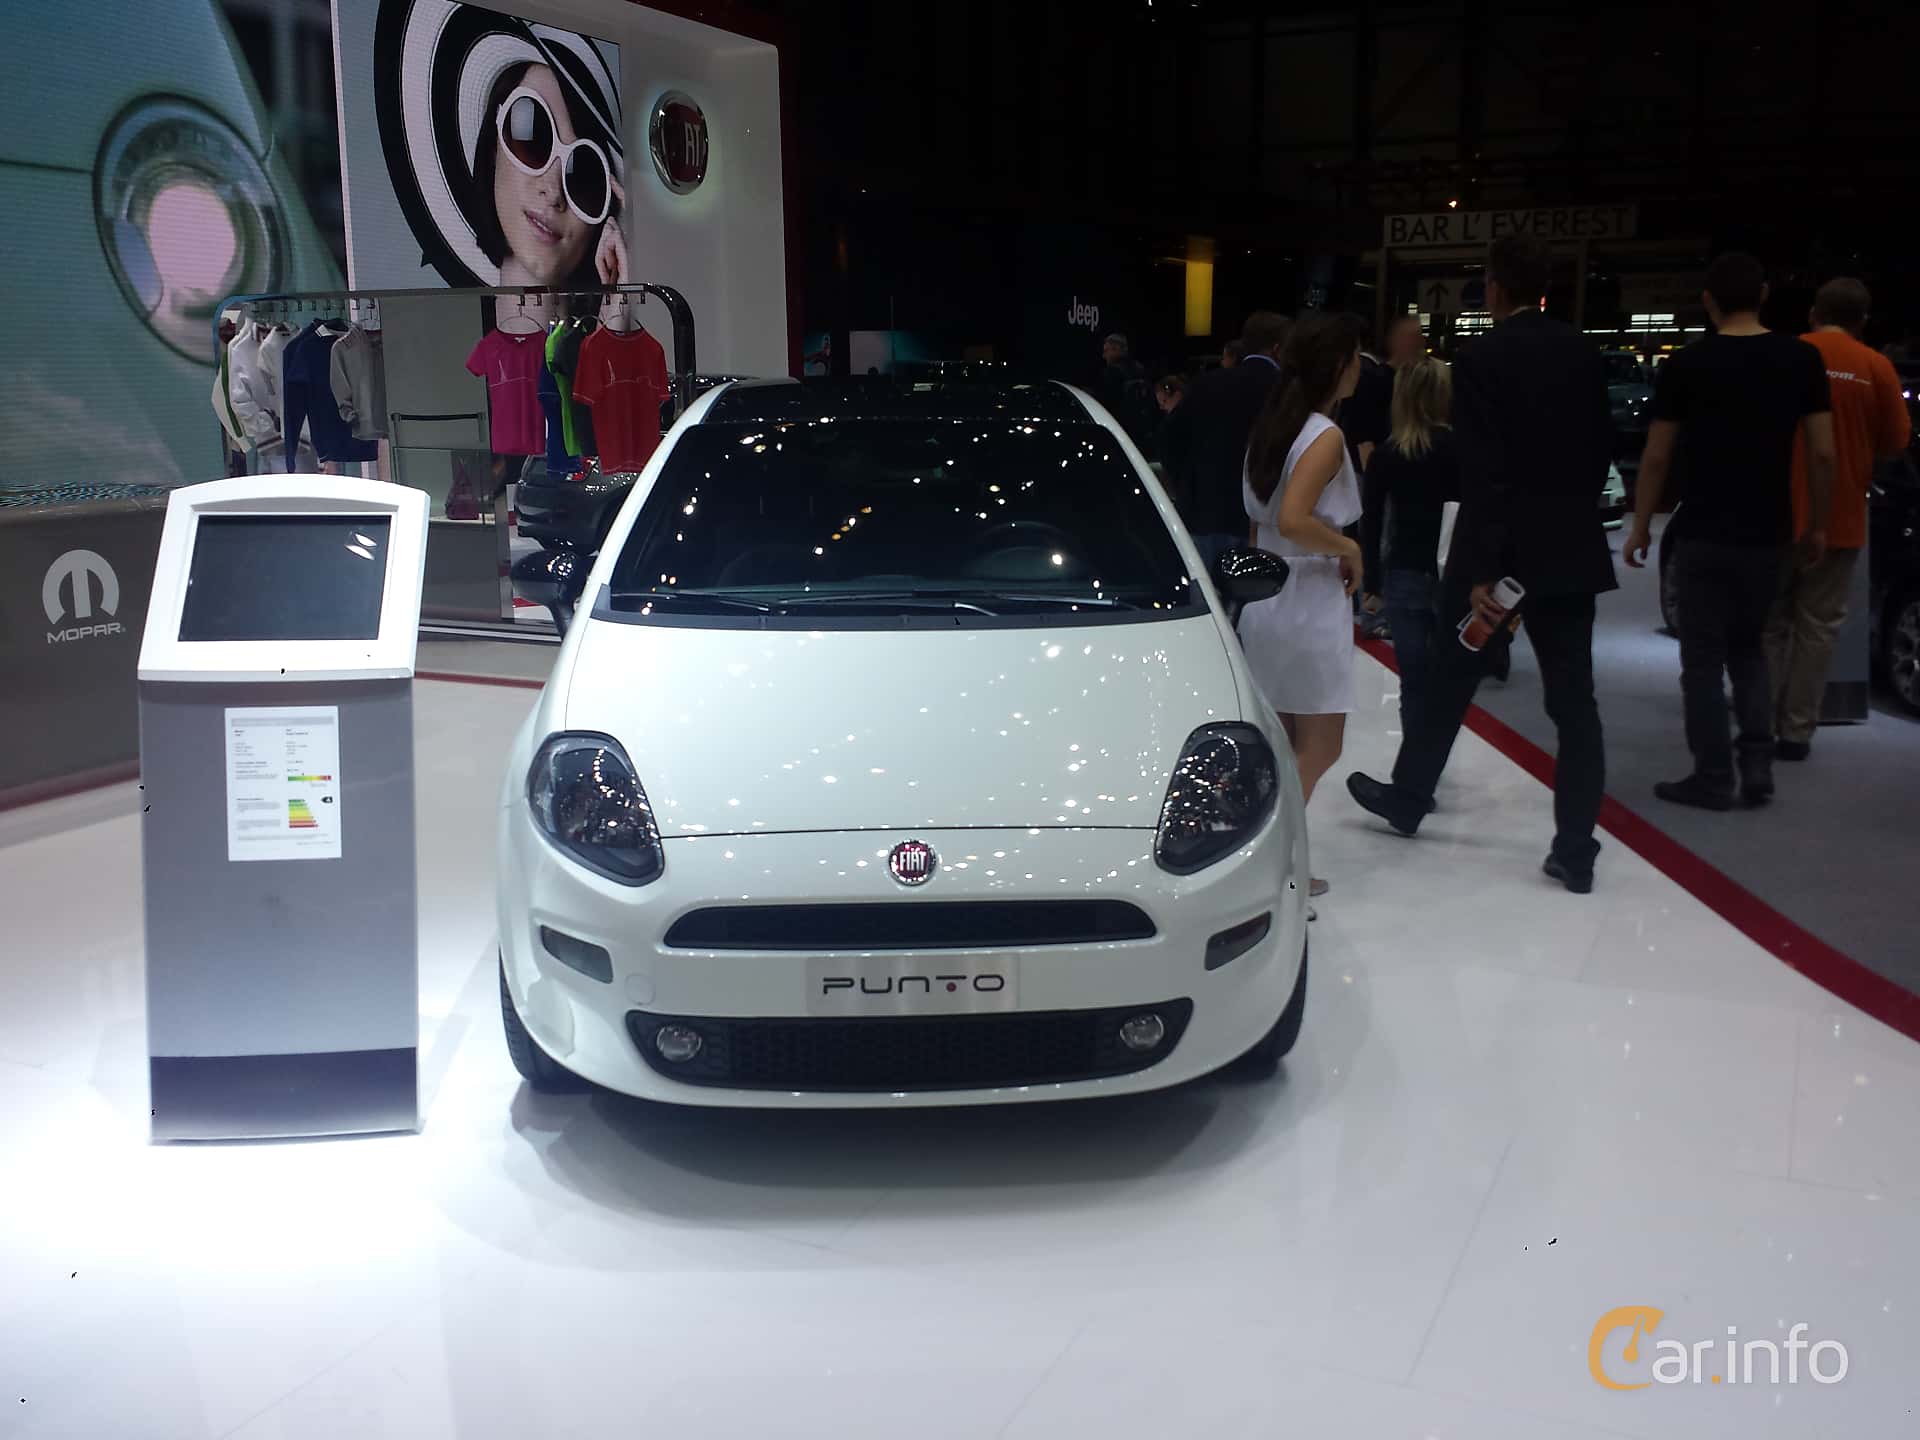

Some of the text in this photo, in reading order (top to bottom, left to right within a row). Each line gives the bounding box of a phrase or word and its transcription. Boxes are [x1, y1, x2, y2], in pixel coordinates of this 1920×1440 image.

[1390, 215, 1449, 242] BAR
[1067, 296, 1100, 332] Jeep
[47, 622, 121, 644] MOPAR
[899, 849, 927, 872] FIAT
[823, 974, 1005, 995] PUNTO
